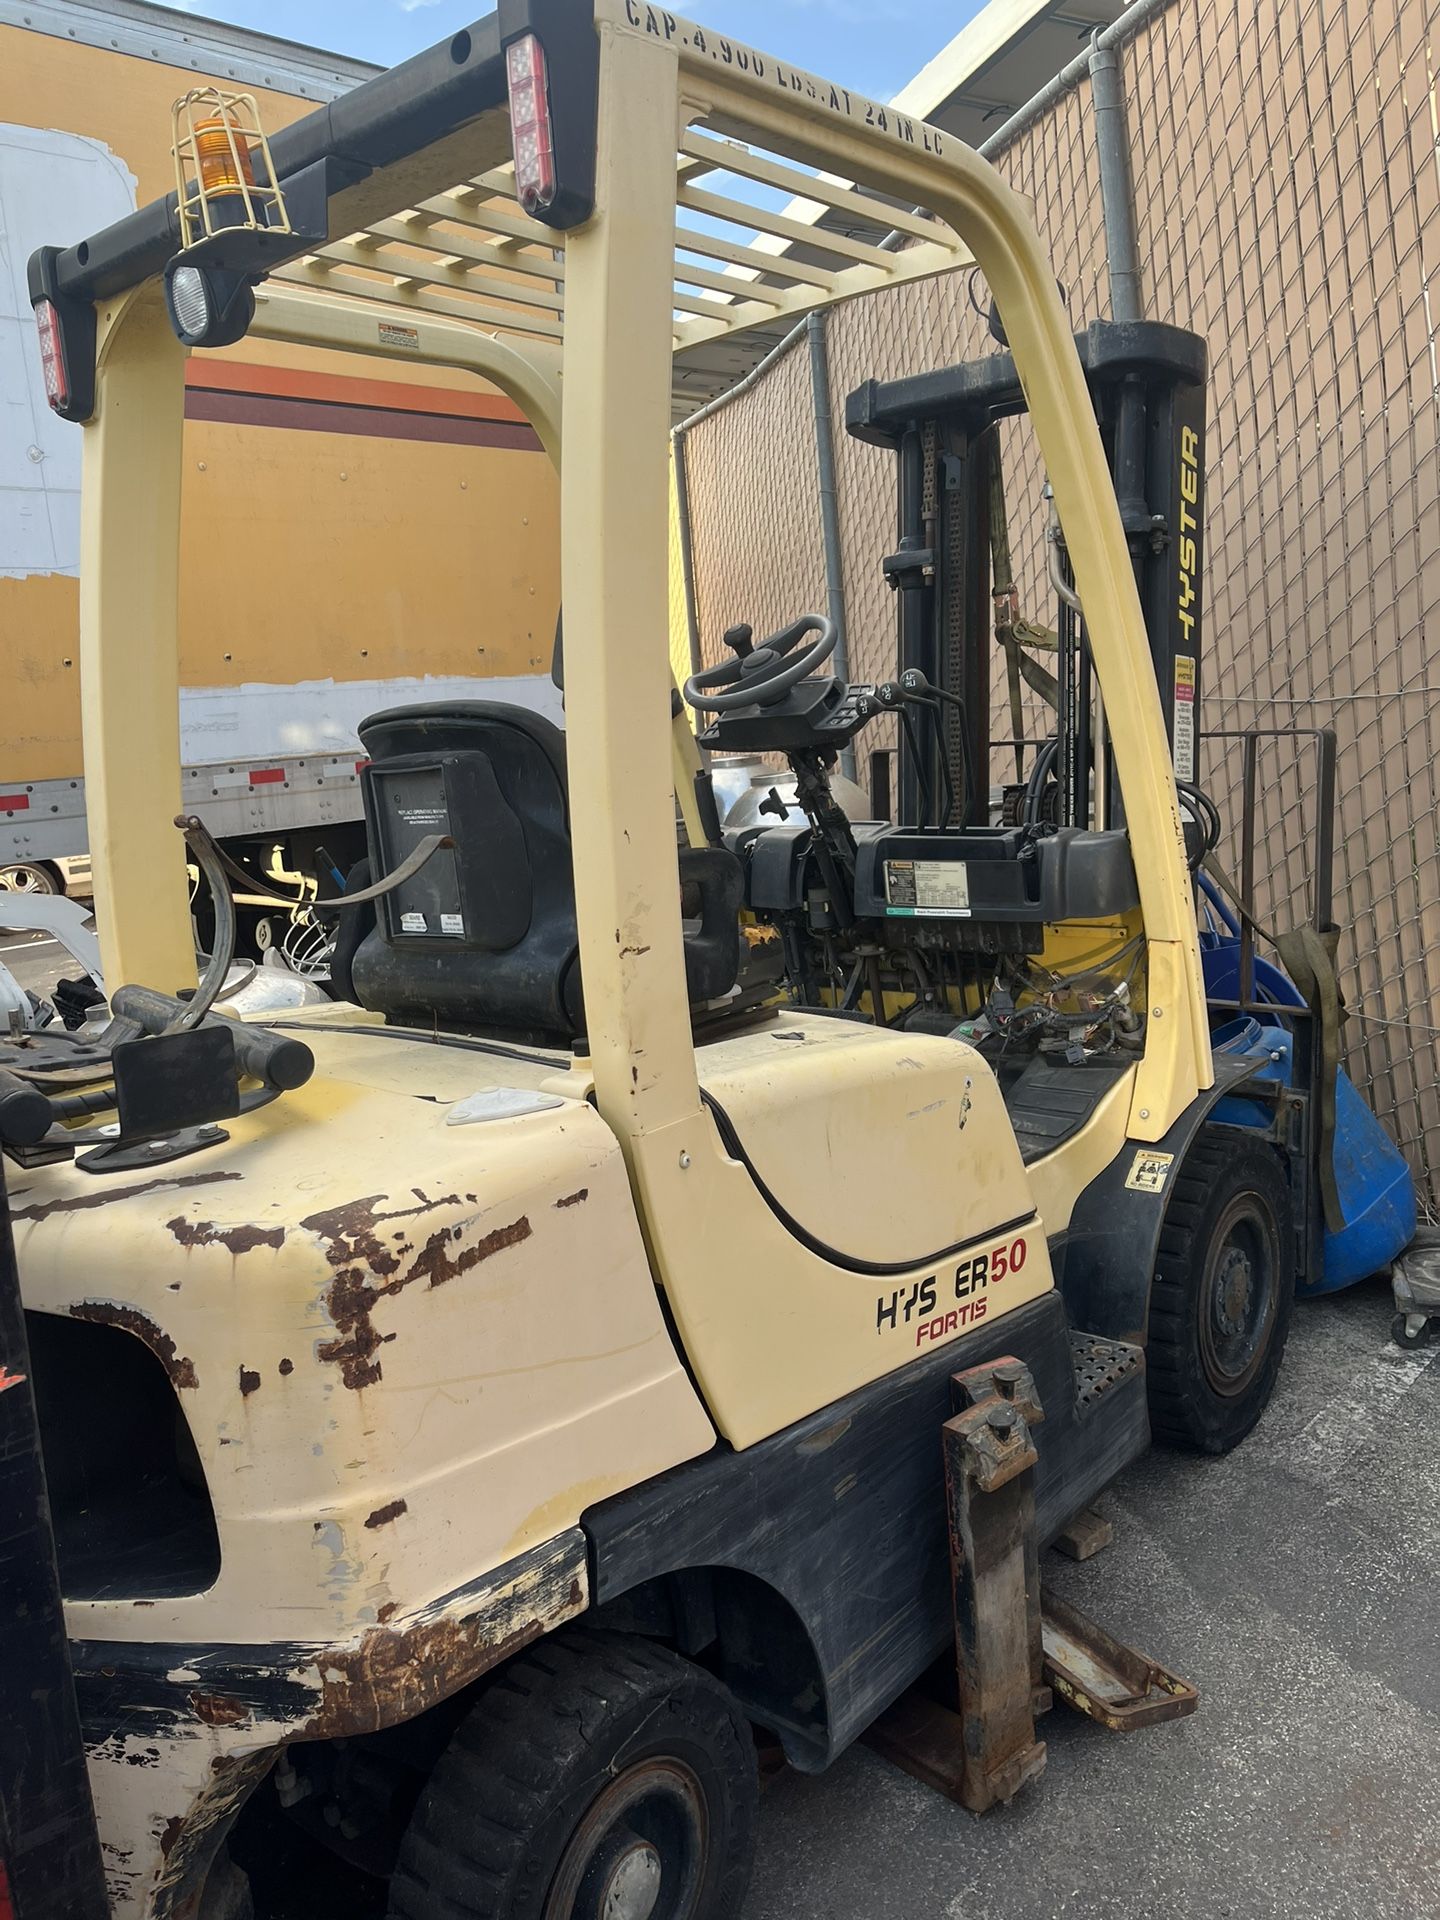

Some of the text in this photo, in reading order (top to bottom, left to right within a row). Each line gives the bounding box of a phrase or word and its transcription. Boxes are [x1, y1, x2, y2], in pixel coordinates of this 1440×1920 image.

[864, 102, 888, 132] 24
[896, 115, 914, 143] IN
[922, 128, 943, 155] LC
[916, 1296, 988, 1347] FORTIS
